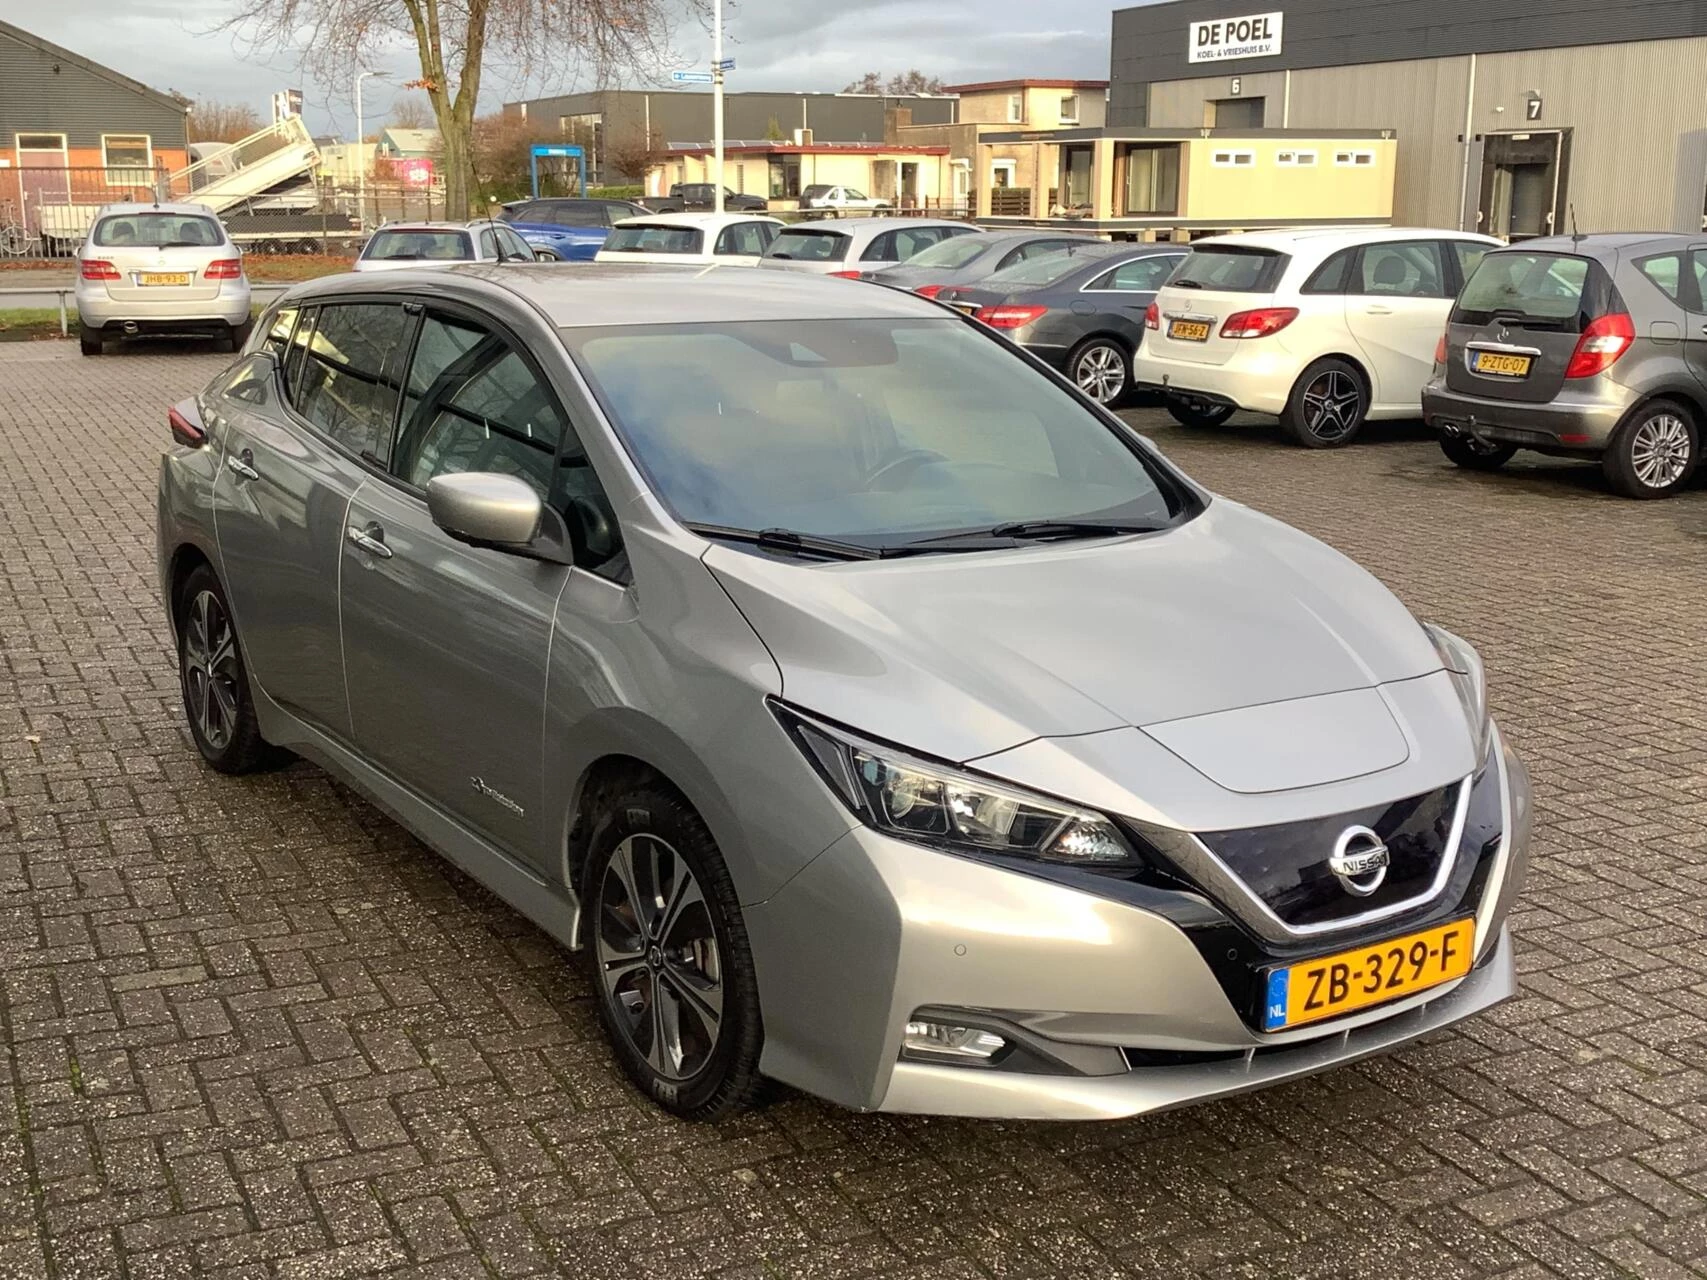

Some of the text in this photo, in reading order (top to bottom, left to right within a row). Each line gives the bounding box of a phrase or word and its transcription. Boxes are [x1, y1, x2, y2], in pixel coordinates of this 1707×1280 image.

[1198, 18, 1273, 46] DE POEL
[1223, 45, 1257, 56] VRIESHUIS
[1258, 44, 1272, 52] B.V.
[1232, 79, 1240, 94] 6
[1530, 101, 1541, 118] 7
[1481, 355, 1526, 372] 9-ZTG-07
[1303, 930, 1459, 1012] ZB-329-F
[1269, 1004, 1285, 1018] NL
